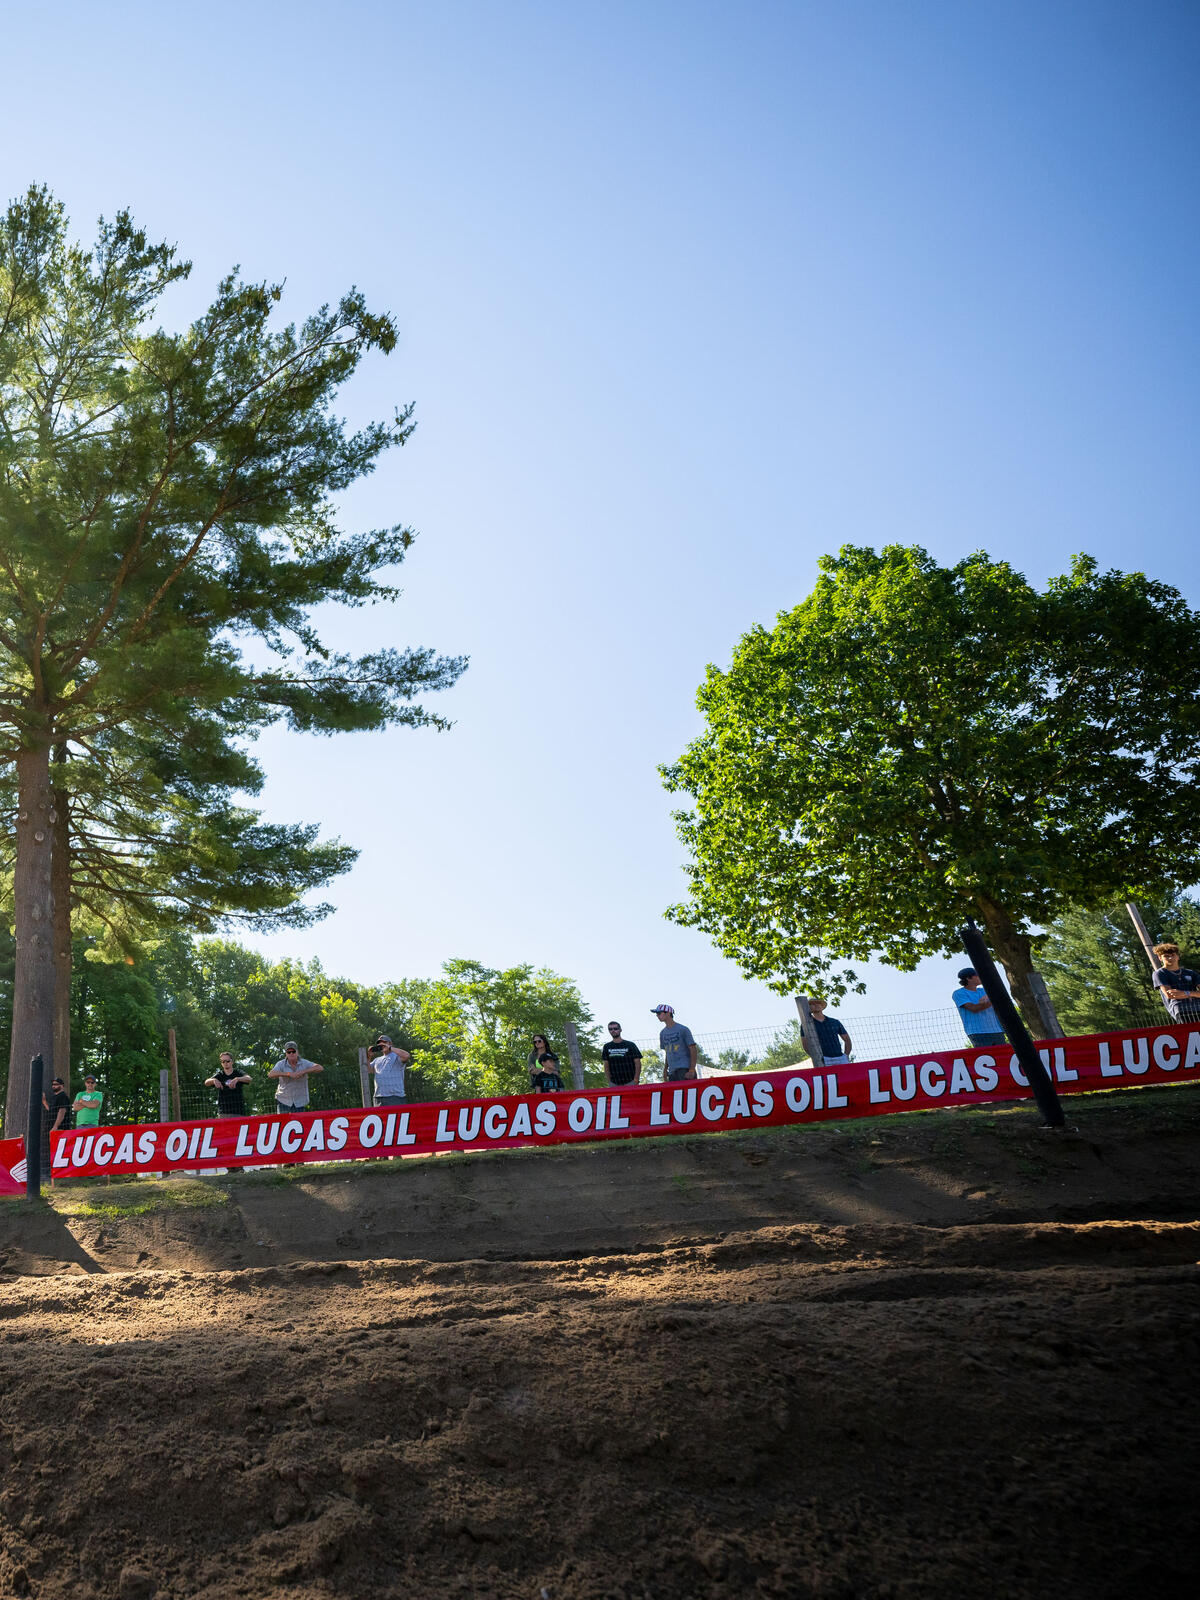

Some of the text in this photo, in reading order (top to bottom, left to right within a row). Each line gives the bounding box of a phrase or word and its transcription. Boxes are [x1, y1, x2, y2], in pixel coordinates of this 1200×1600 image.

[52, 1131, 158, 1168] LUCAS
[165, 1127, 218, 1161] OIL
[234, 1117, 349, 1157] LUCAS
[359, 1112, 416, 1148] OIL
[435, 1100, 557, 1142] LUCAS
[568, 1095, 629, 1132] OIL
[650, 1080, 774, 1126] LUCAS
[785, 1074, 848, 1113] OIL
[868, 1054, 999, 1104] LUCAS
